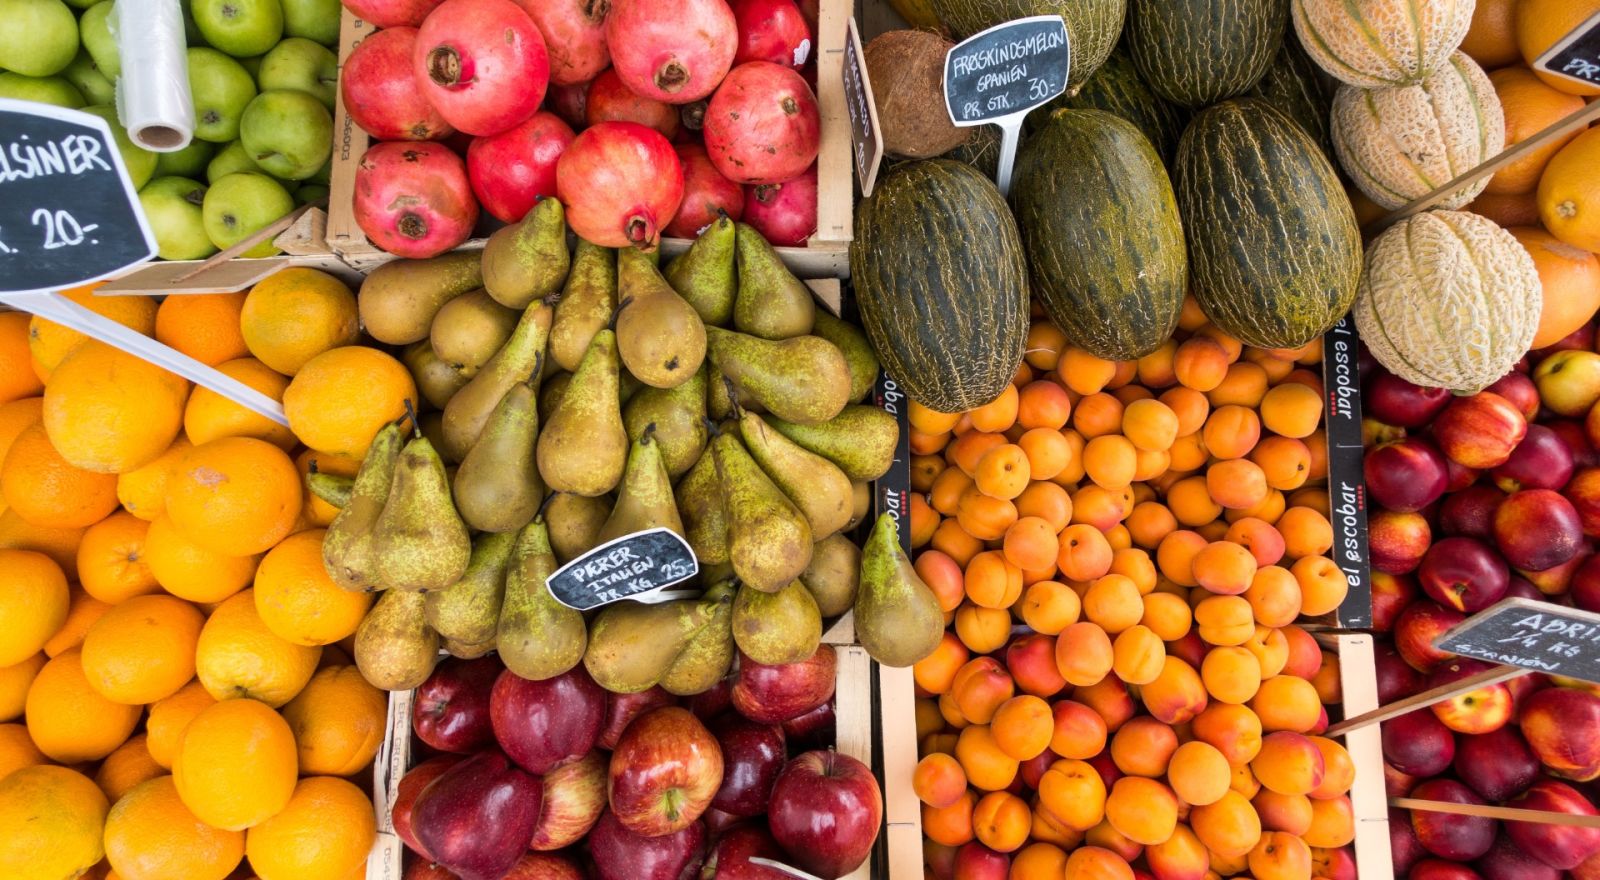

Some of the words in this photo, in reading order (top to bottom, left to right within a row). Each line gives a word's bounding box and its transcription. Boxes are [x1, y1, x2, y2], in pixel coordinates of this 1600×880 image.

[976, 63, 1028, 92] SPANIEN
[963, 101, 985, 120] PR.
[0, 134, 111, 183] LSINER
[1335, 341, 1357, 420] escobar
[1336, 481, 1360, 562] escobar
[587, 556, 655, 592] ITALIEN
[1342, 567, 1361, 587] el
